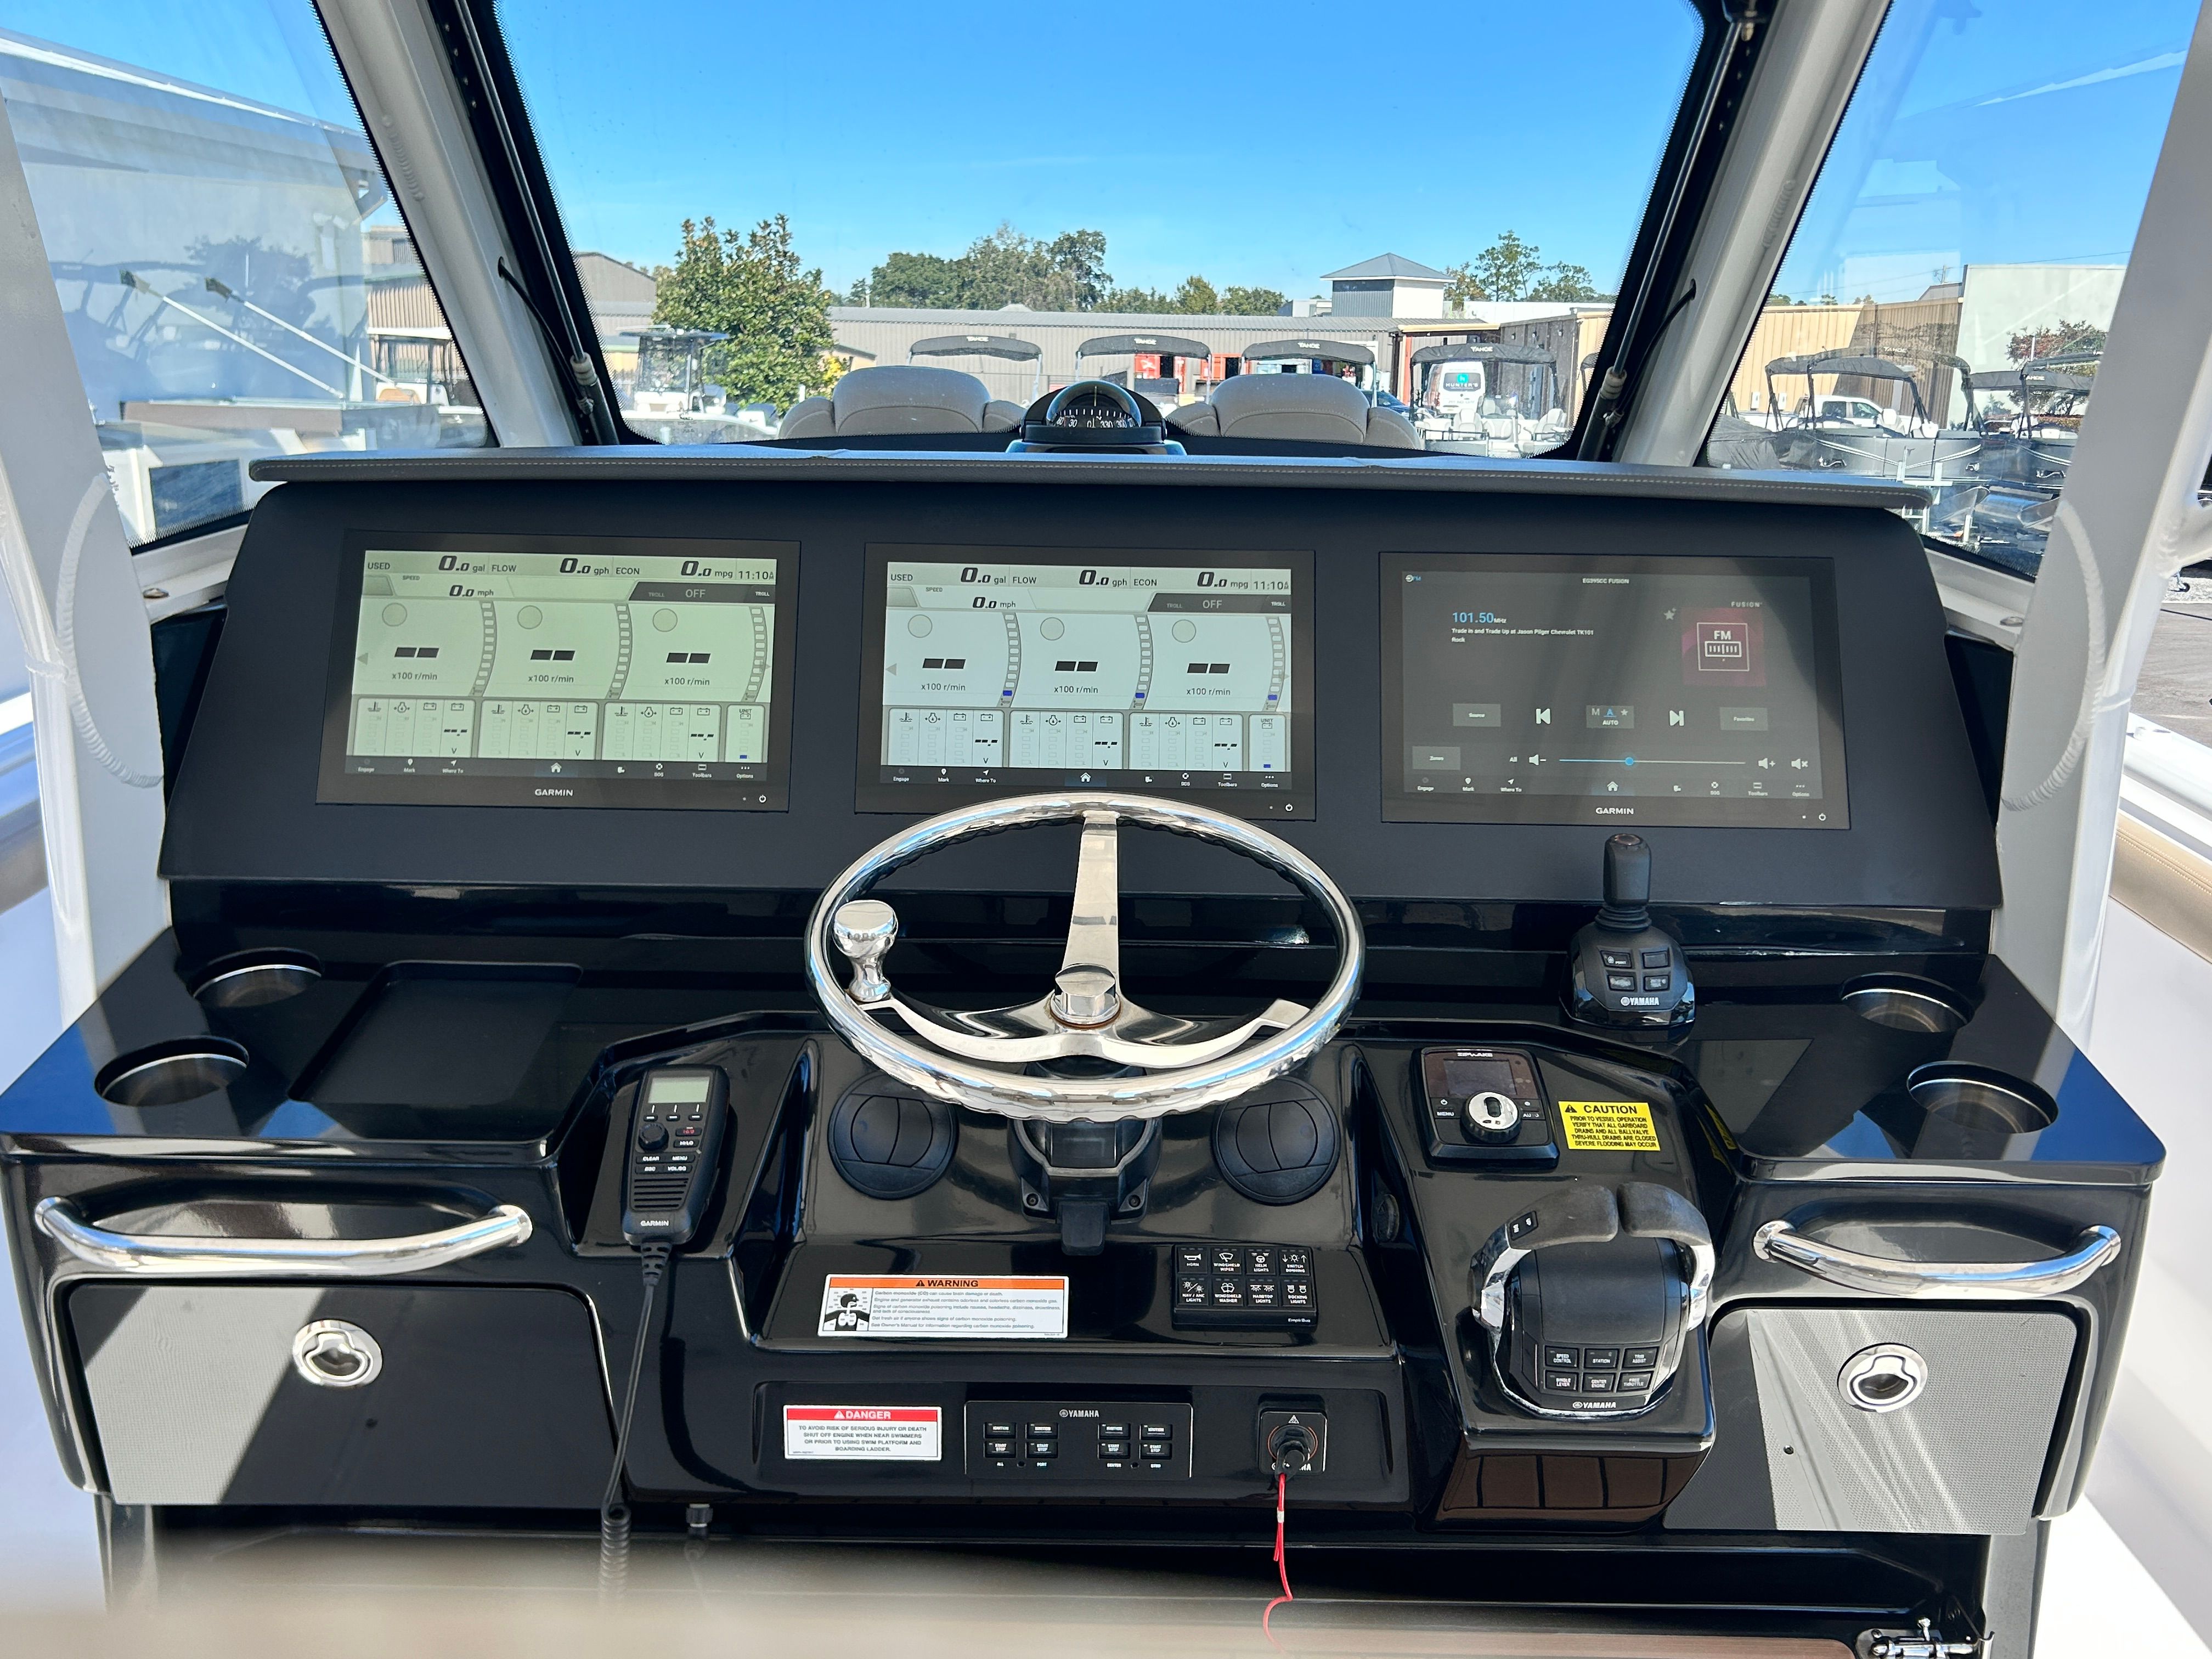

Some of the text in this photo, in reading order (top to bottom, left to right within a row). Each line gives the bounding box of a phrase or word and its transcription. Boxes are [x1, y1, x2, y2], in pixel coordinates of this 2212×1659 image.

[1069, 419, 1077, 427] 30
[367, 555, 485, 573] USED 0.0 gal
[491, 557, 610, 577] FLOW 0.0 gph
[616, 560, 733, 579] ECON 0.0 mpg
[890, 567, 1006, 585] USED 0.0 gal
[1012, 569, 1127, 588] FLOW 0.0 gph
[1133, 572, 1249, 590] ECON 0.0 mpg
[449, 585, 475, 597] 0.0
[685, 589, 707, 599] OFF
[972, 596, 997, 609] 0.0
[1202, 600, 1222, 609] OFF
[1714, 630, 1731, 640] FM
[392, 672, 437, 680] x100 r/min
[528, 674, 574, 683] x100 r/min
[664, 678, 710, 686] x100 r/min
[943, 682, 966, 691] r/min
[1075, 685, 1099, 694] r/min
[1208, 687, 1231, 696] r/min
[1591, 708, 1613, 716] M A
[534, 788, 574, 797] GARMIN
[1595, 807, 1634, 815] GARMIN
[1630, 997, 1660, 1006] YAMAHA
[1583, 1105, 1638, 1114] CAUTION
[928, 1279, 979, 1288] WARNING
[845, 1410, 891, 1419] DANGER
[1069, 1409, 1099, 1418] YAMAHA
